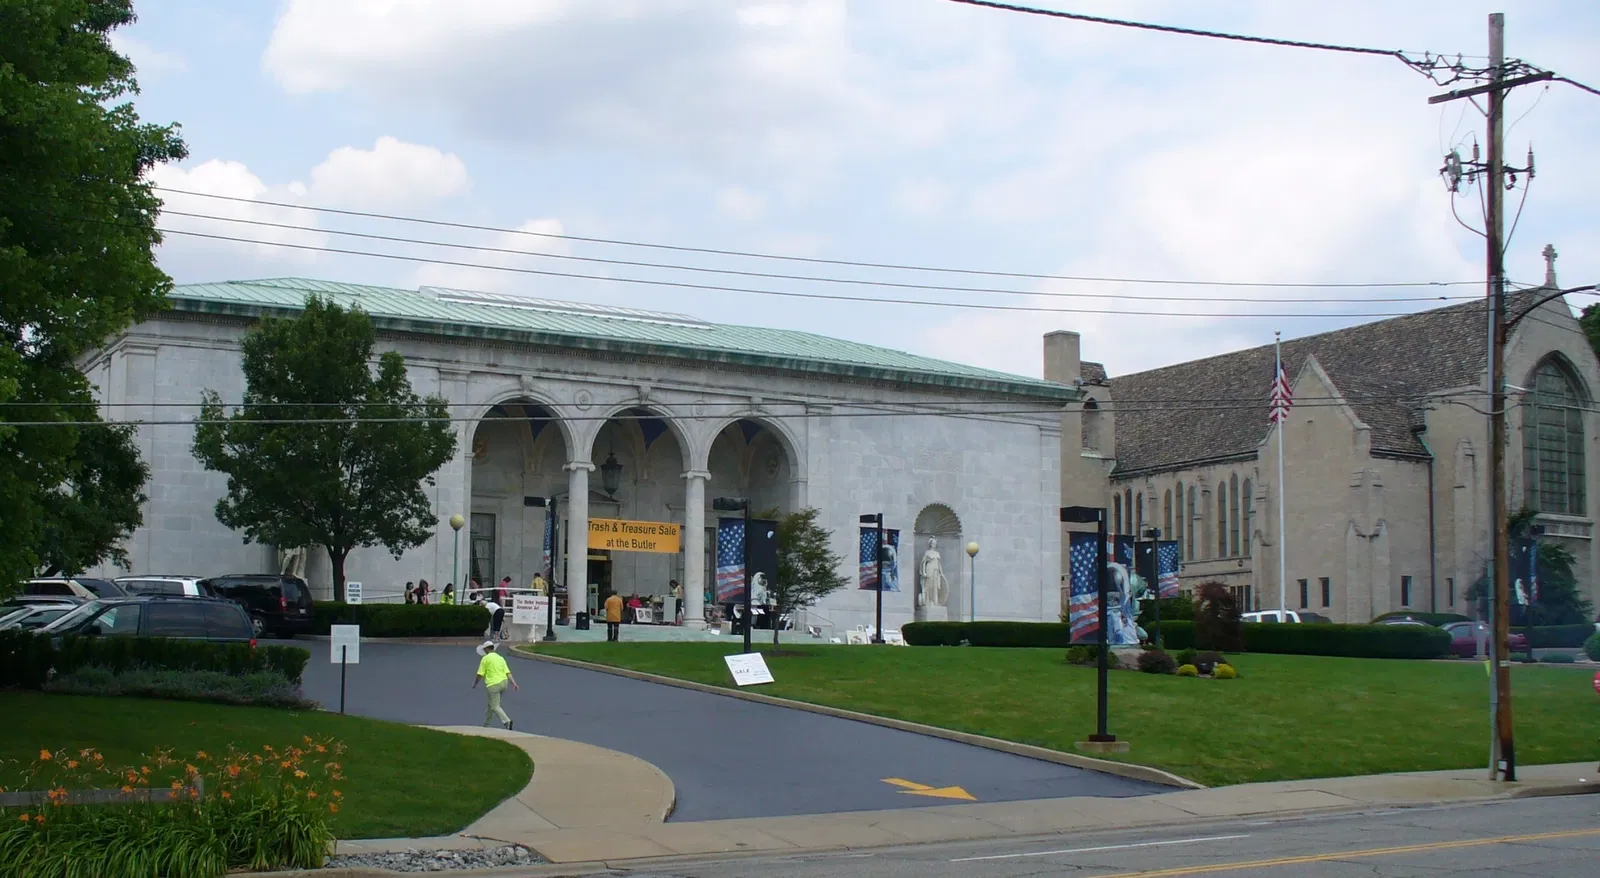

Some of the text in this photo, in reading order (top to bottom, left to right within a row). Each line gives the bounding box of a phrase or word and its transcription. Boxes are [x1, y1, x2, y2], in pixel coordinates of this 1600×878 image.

[588, 521, 677, 536] Trash & Treasure Sale
[606, 539, 657, 550] at the Butler
